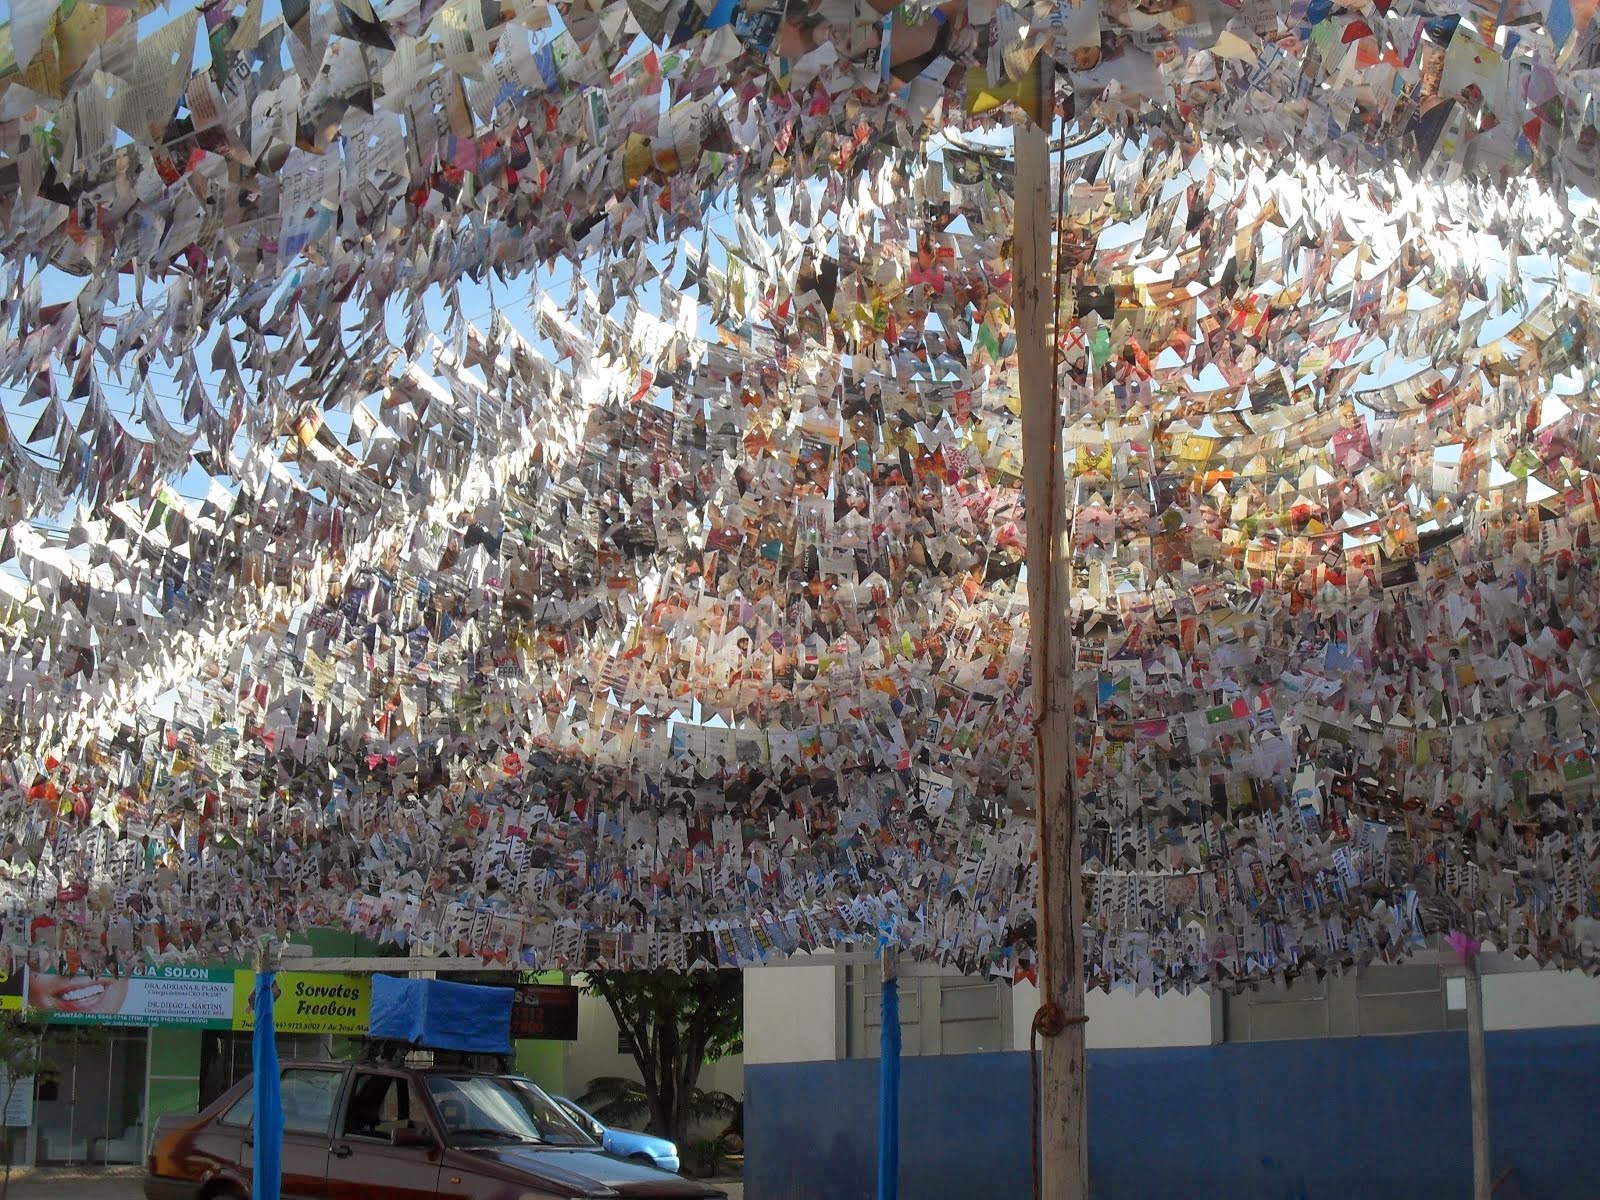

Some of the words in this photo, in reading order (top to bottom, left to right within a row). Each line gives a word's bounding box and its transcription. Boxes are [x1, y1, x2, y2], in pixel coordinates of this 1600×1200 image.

[164, 967, 209, 979] SOLON
[144, 982, 160, 990] DRA.
[161, 983, 193, 991] ADRIANA
[295, 981, 359, 1000] Sorvetes
[191, 1003, 222, 1011] MARTINS
[297, 1000, 357, 1017] Freebon
